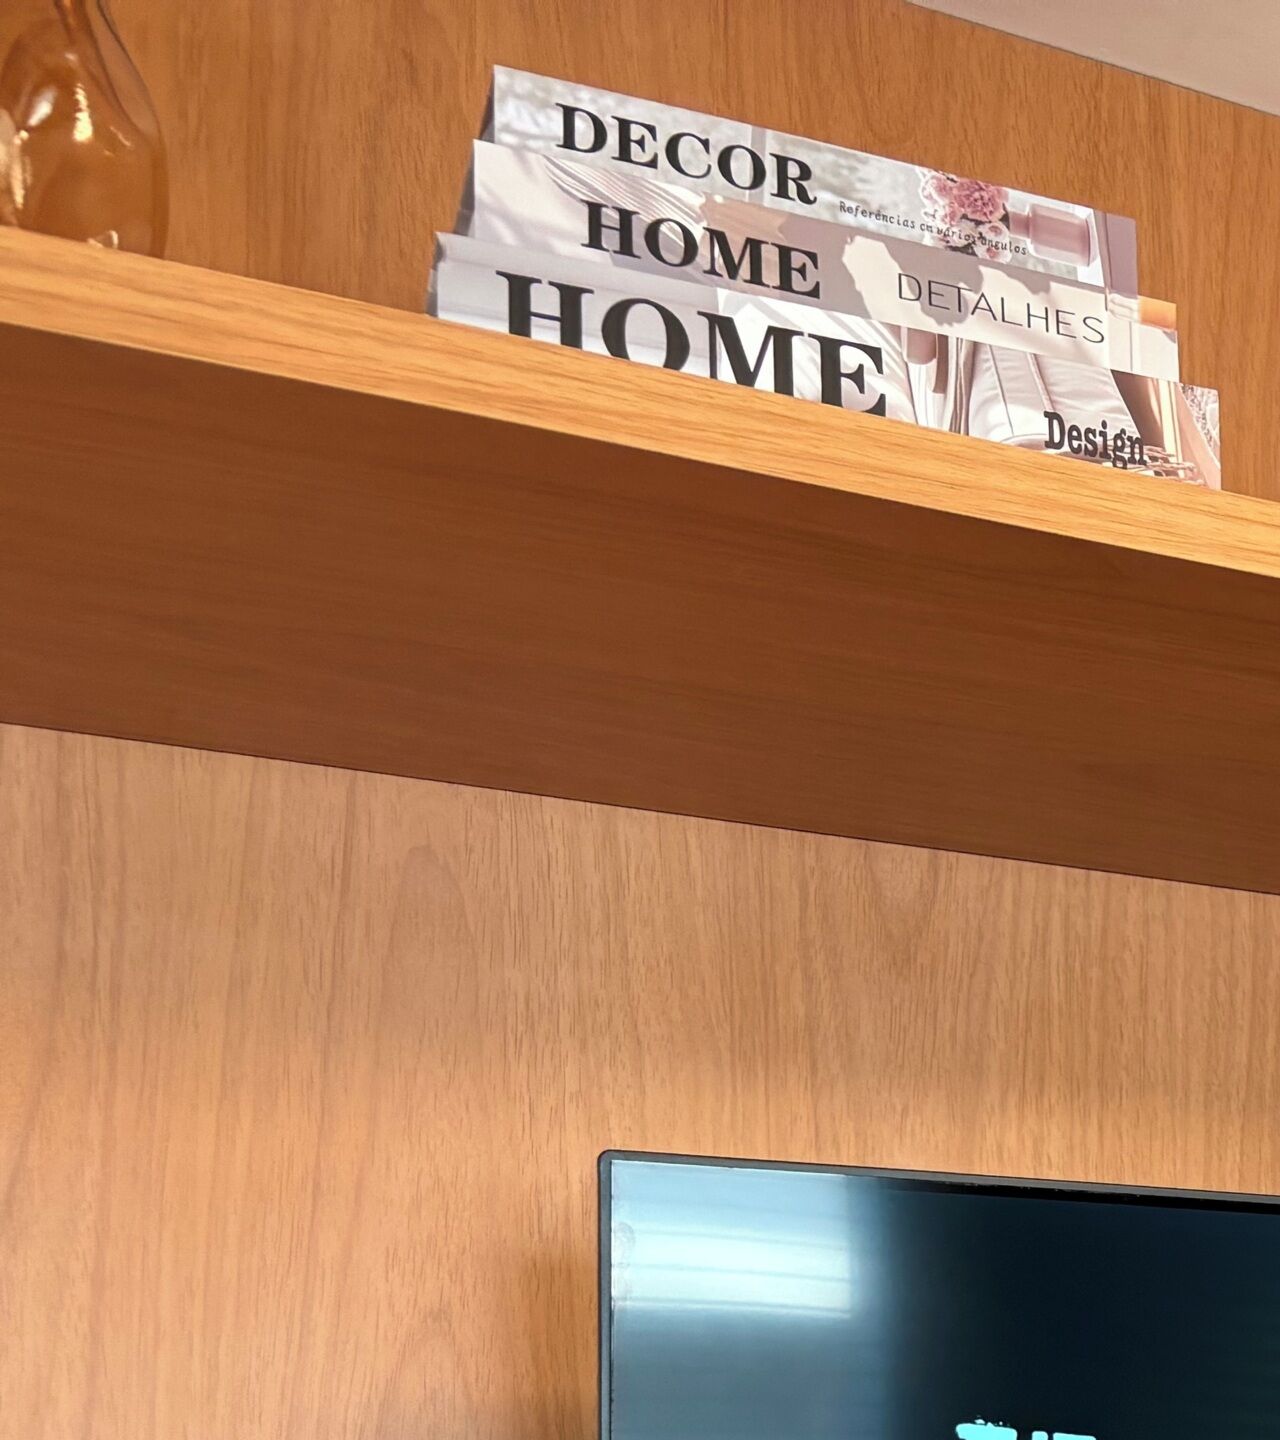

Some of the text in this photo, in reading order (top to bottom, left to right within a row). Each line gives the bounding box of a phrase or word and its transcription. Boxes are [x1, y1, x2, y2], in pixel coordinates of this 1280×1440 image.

[555, 102, 818, 204] DECOR
[579, 199, 820, 299] HOME
[839, 200, 915, 228] Referências
[919, 222, 933, 233] em
[496, 270, 887, 417] HOME
[898, 273, 1105, 344] DETALHES
[1043, 411, 1147, 470] Design
